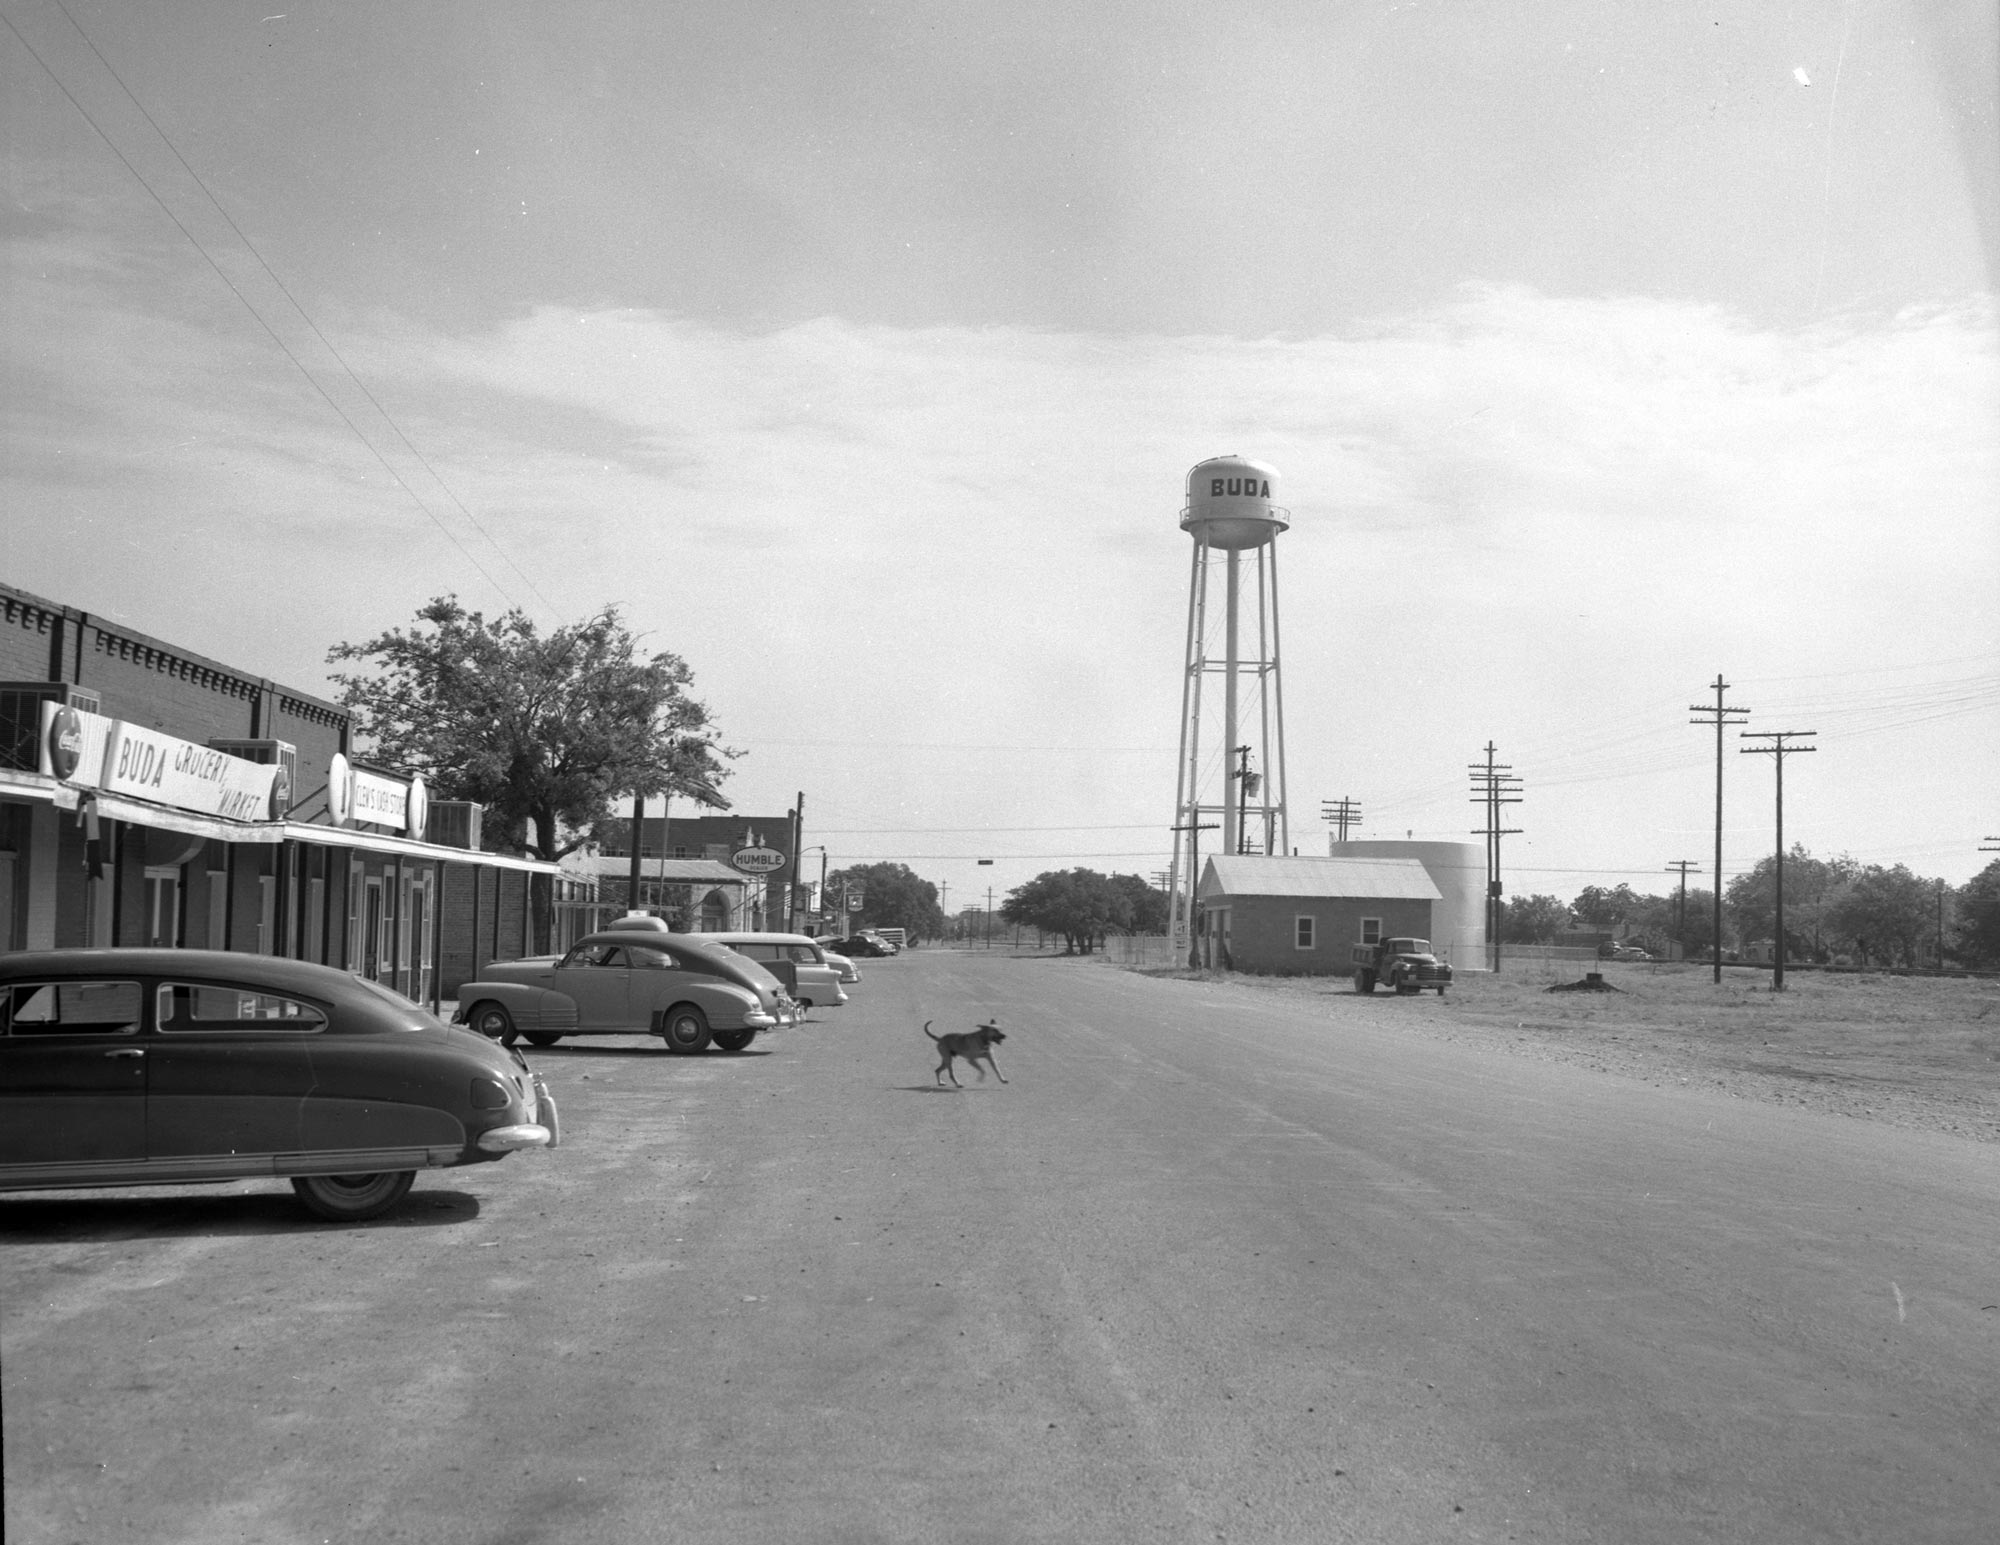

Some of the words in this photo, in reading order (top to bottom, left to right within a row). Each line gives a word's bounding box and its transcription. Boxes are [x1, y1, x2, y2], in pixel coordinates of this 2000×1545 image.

[1211, 478, 1270, 499] BUDA
[117, 736, 167, 788] BUDA
[175, 744, 231, 783] GROCERY
[736, 854, 782, 865] HUMBLE
